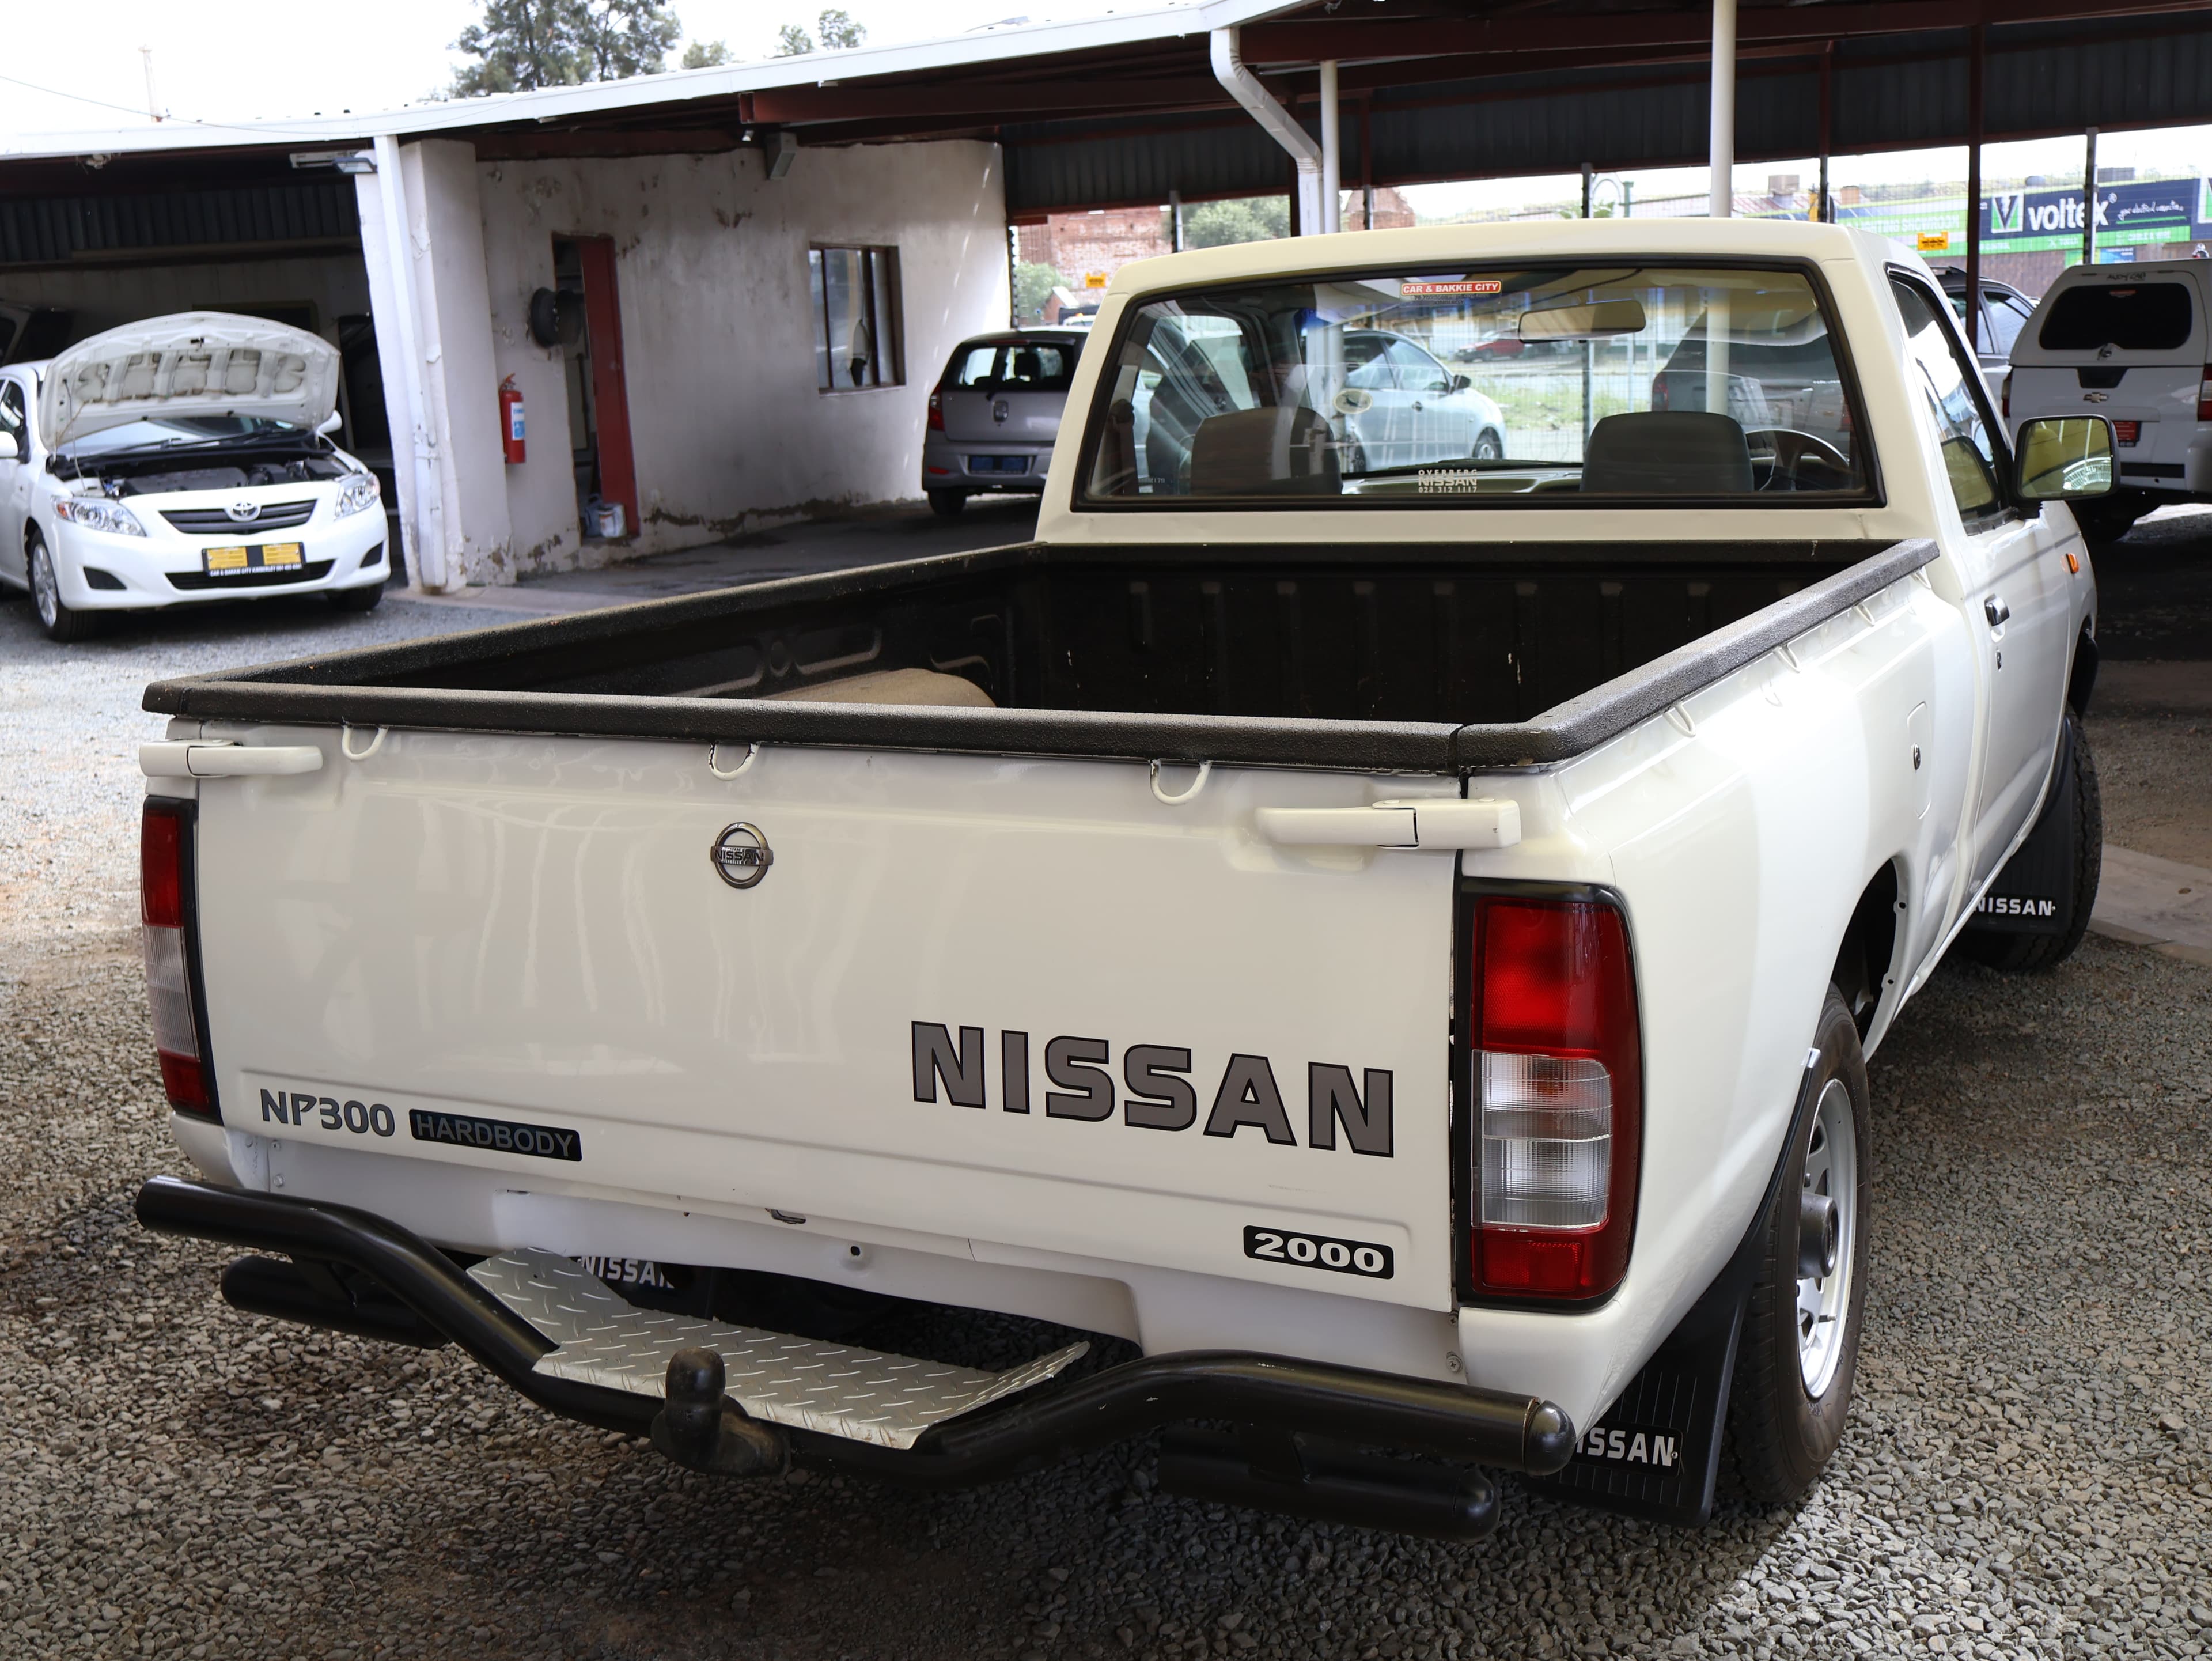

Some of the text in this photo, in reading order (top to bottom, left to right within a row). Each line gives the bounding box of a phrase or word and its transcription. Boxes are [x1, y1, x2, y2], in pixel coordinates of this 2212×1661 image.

[1436, 284, 1472, 292] BAKKIE
[1418, 477, 1477, 486] NISSAN
[715, 849, 764, 861] NISSAN
[1975, 897, 2052, 916] NISSAN
[911, 1020, 1394, 1158] NISSAN
[260, 1088, 573, 1157] NP300 HARDBODY
[1254, 1232, 1384, 1273] 2000
[1576, 1427, 1675, 1466] ISSAN
